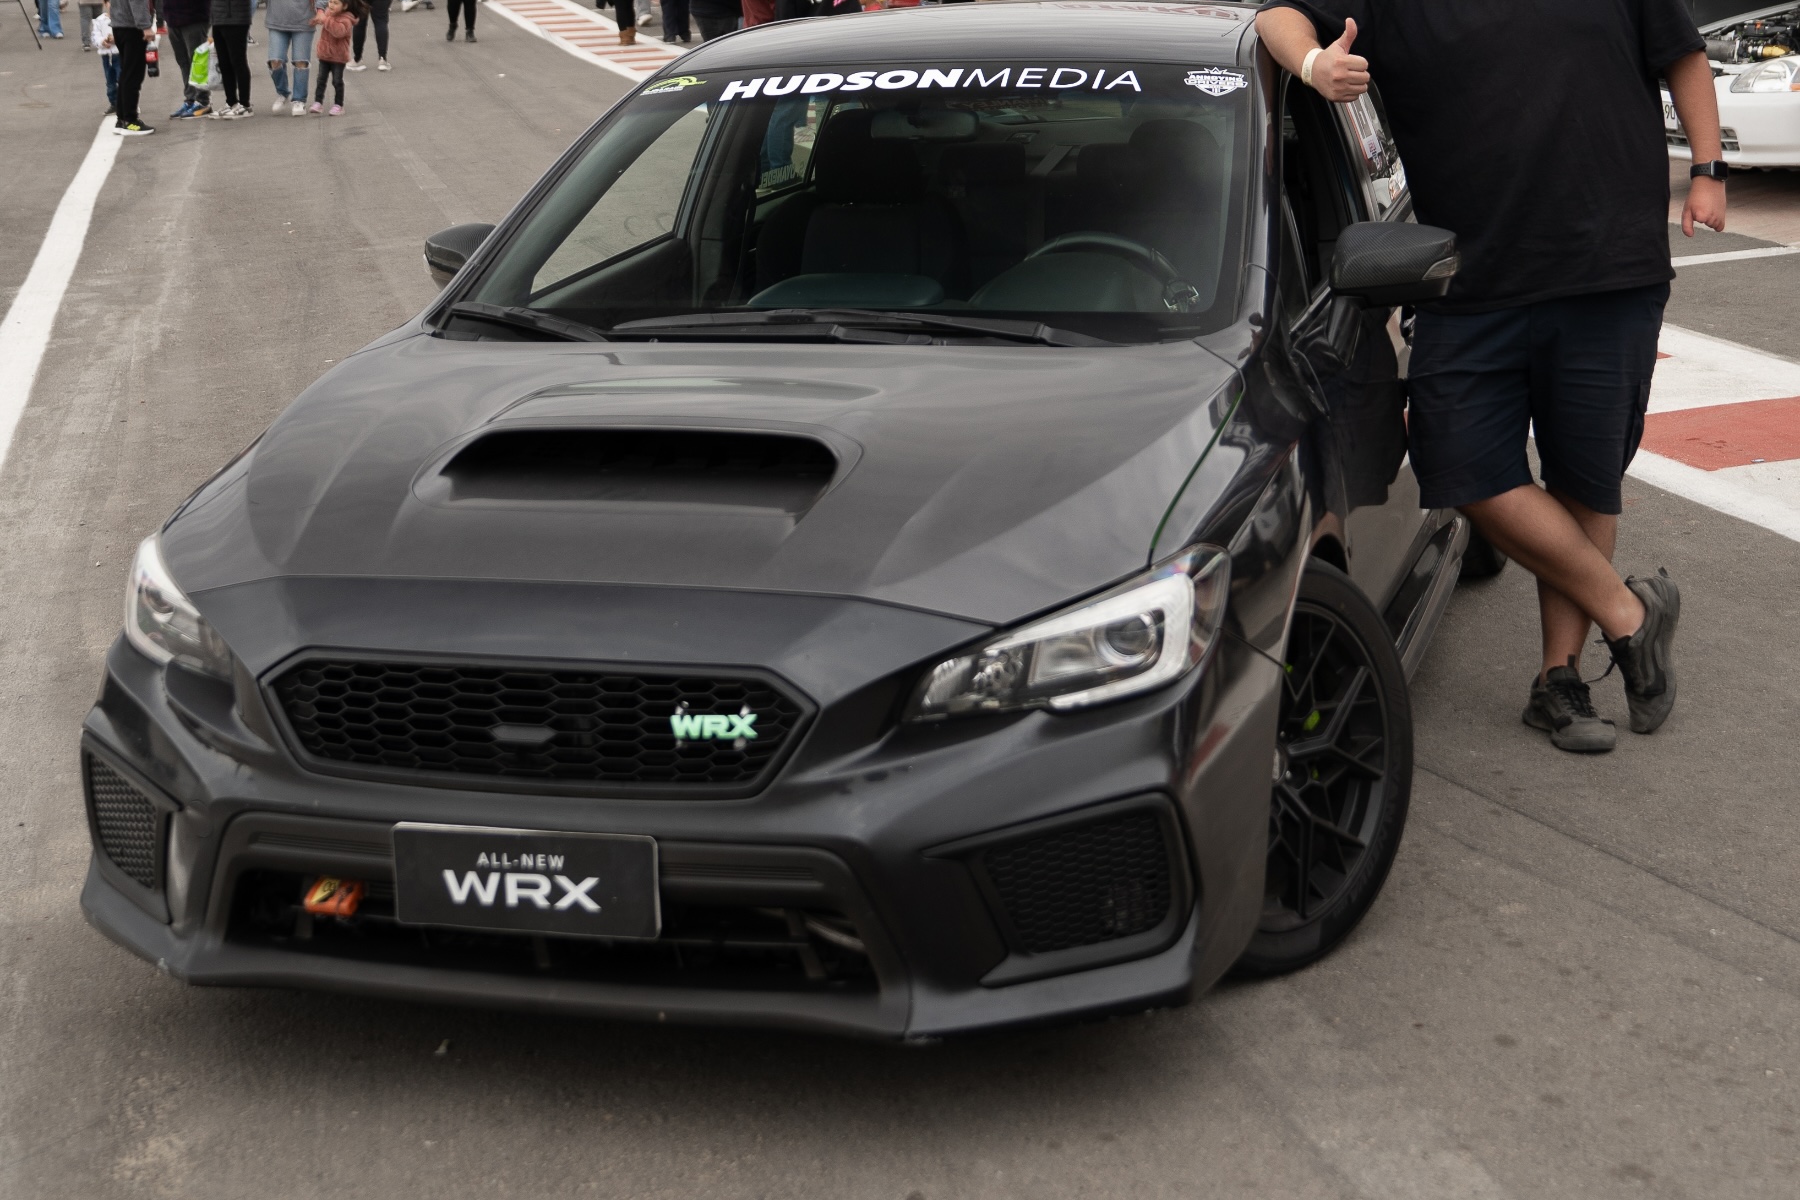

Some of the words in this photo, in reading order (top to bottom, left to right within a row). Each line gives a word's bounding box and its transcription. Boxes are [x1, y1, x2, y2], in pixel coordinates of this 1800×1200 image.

[719, 67, 1143, 102] HUDSONMEDIA
[670, 713, 758, 739] WRX
[477, 851, 565, 871] ALL-NEW
[442, 869, 602, 913] WRX
